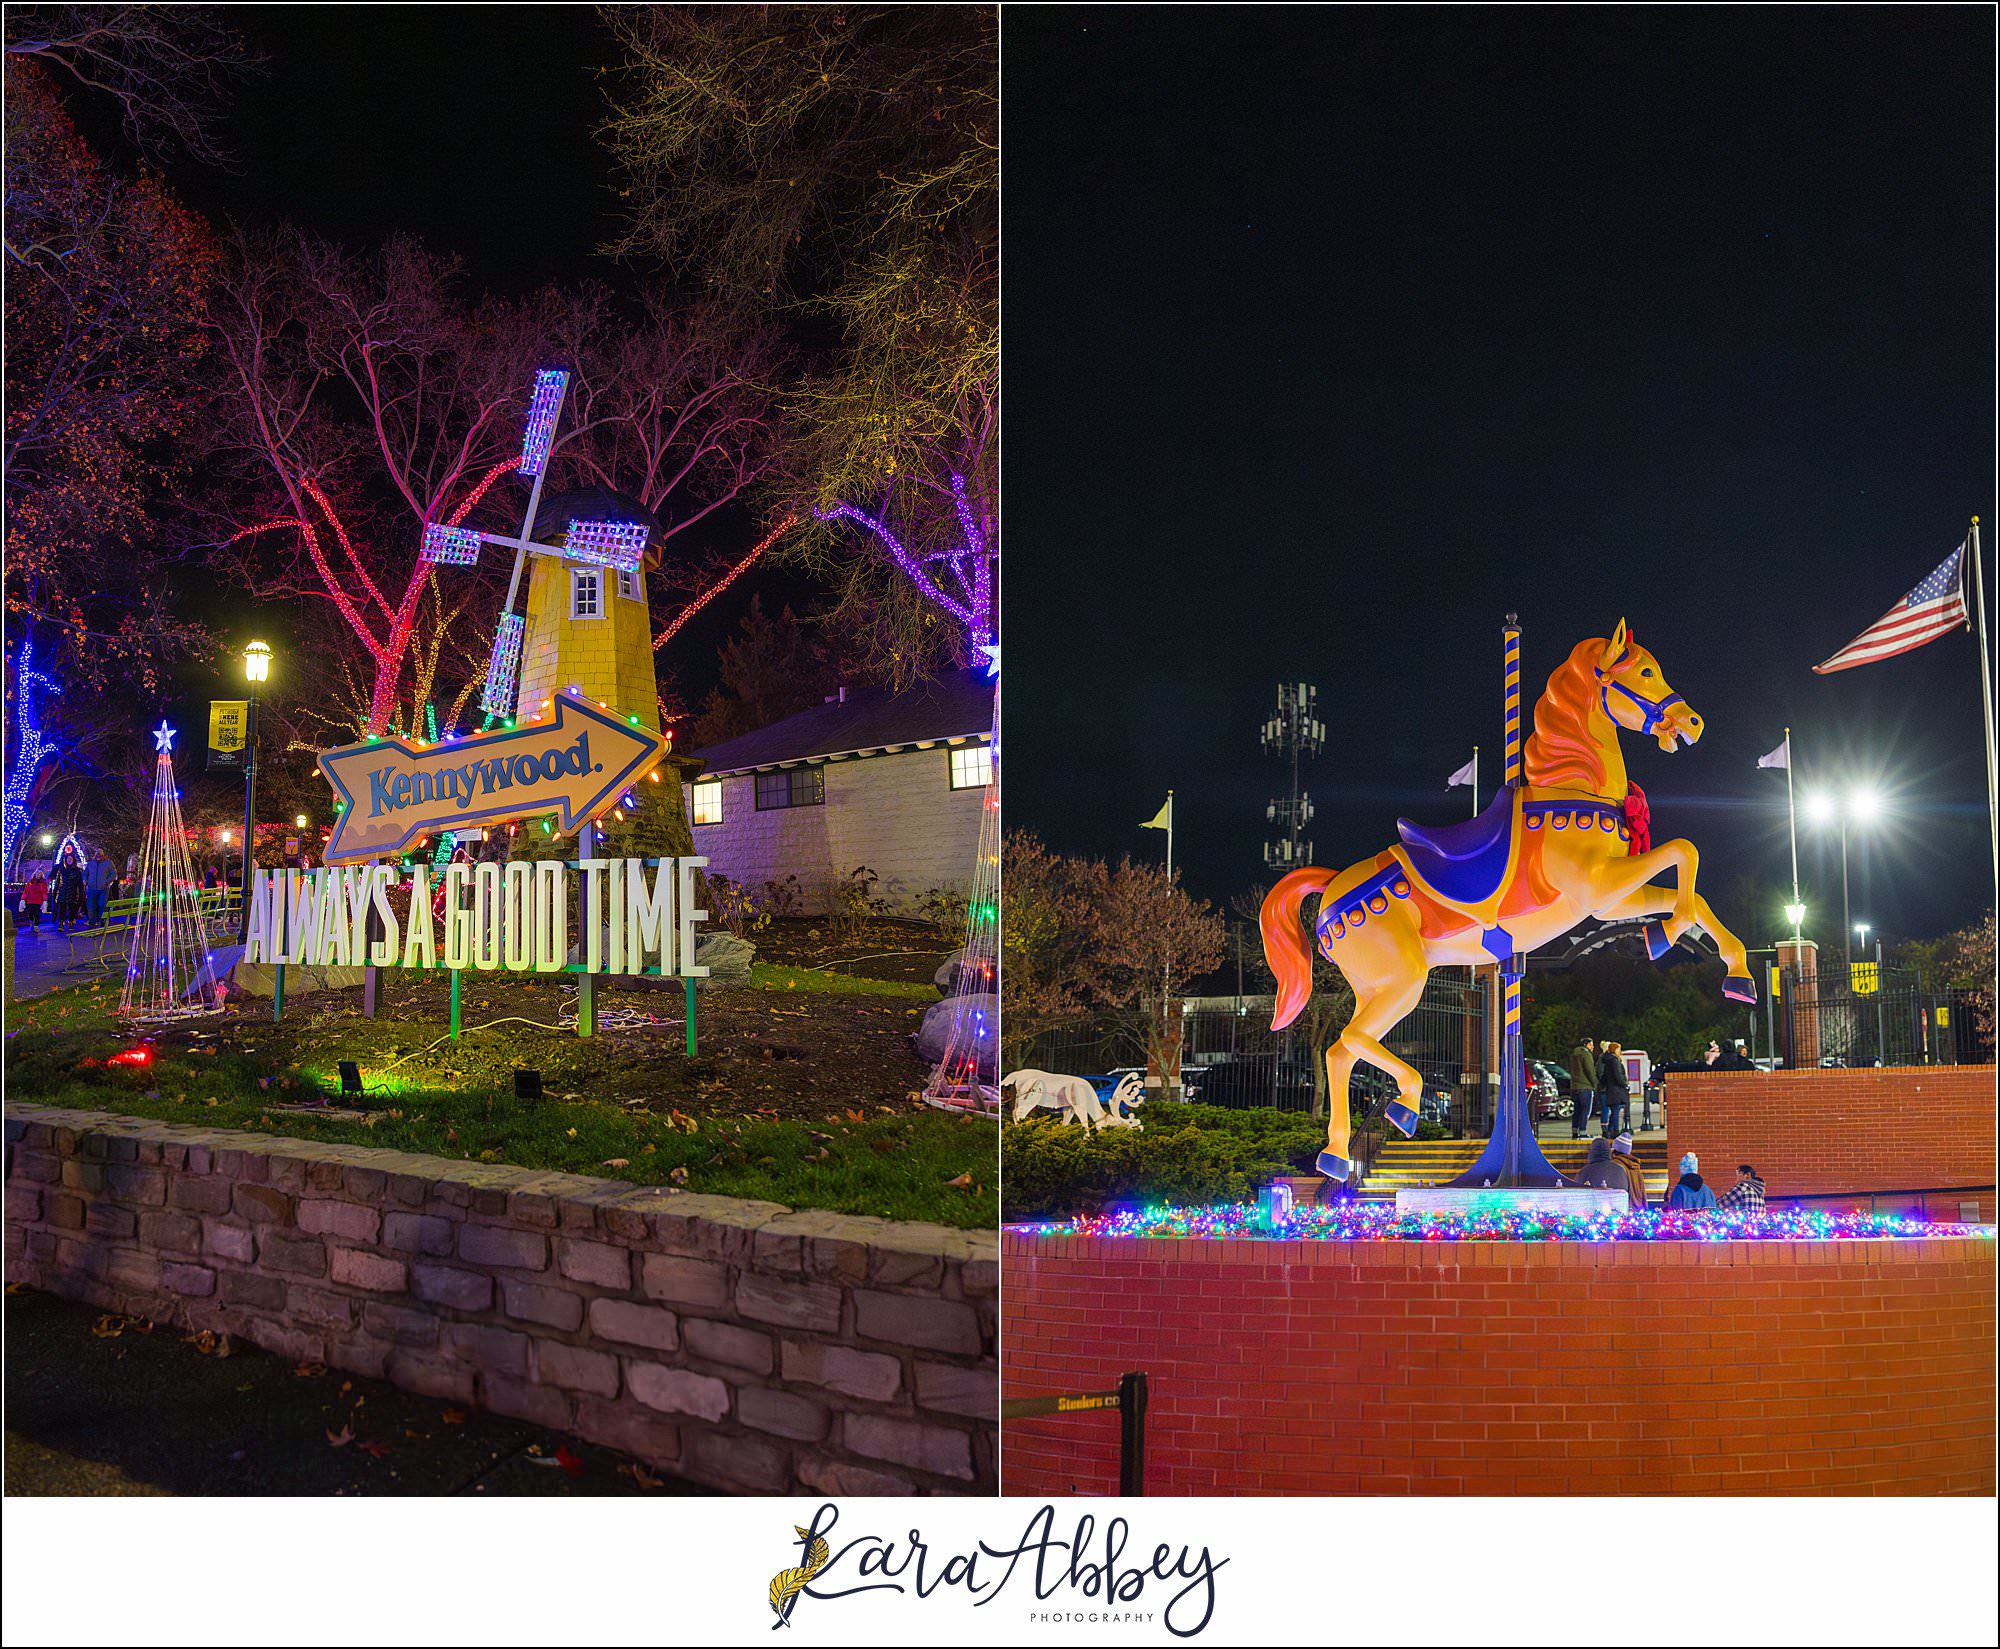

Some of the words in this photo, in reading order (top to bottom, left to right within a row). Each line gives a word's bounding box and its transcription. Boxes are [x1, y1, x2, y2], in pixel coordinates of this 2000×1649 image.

[367, 730, 603, 818] Kennywood.
[244, 865, 400, 967] ALWAYS
[403, 864, 436, 968] A
[445, 861, 567, 973] GOOD
[579, 857, 711, 977] TIME
